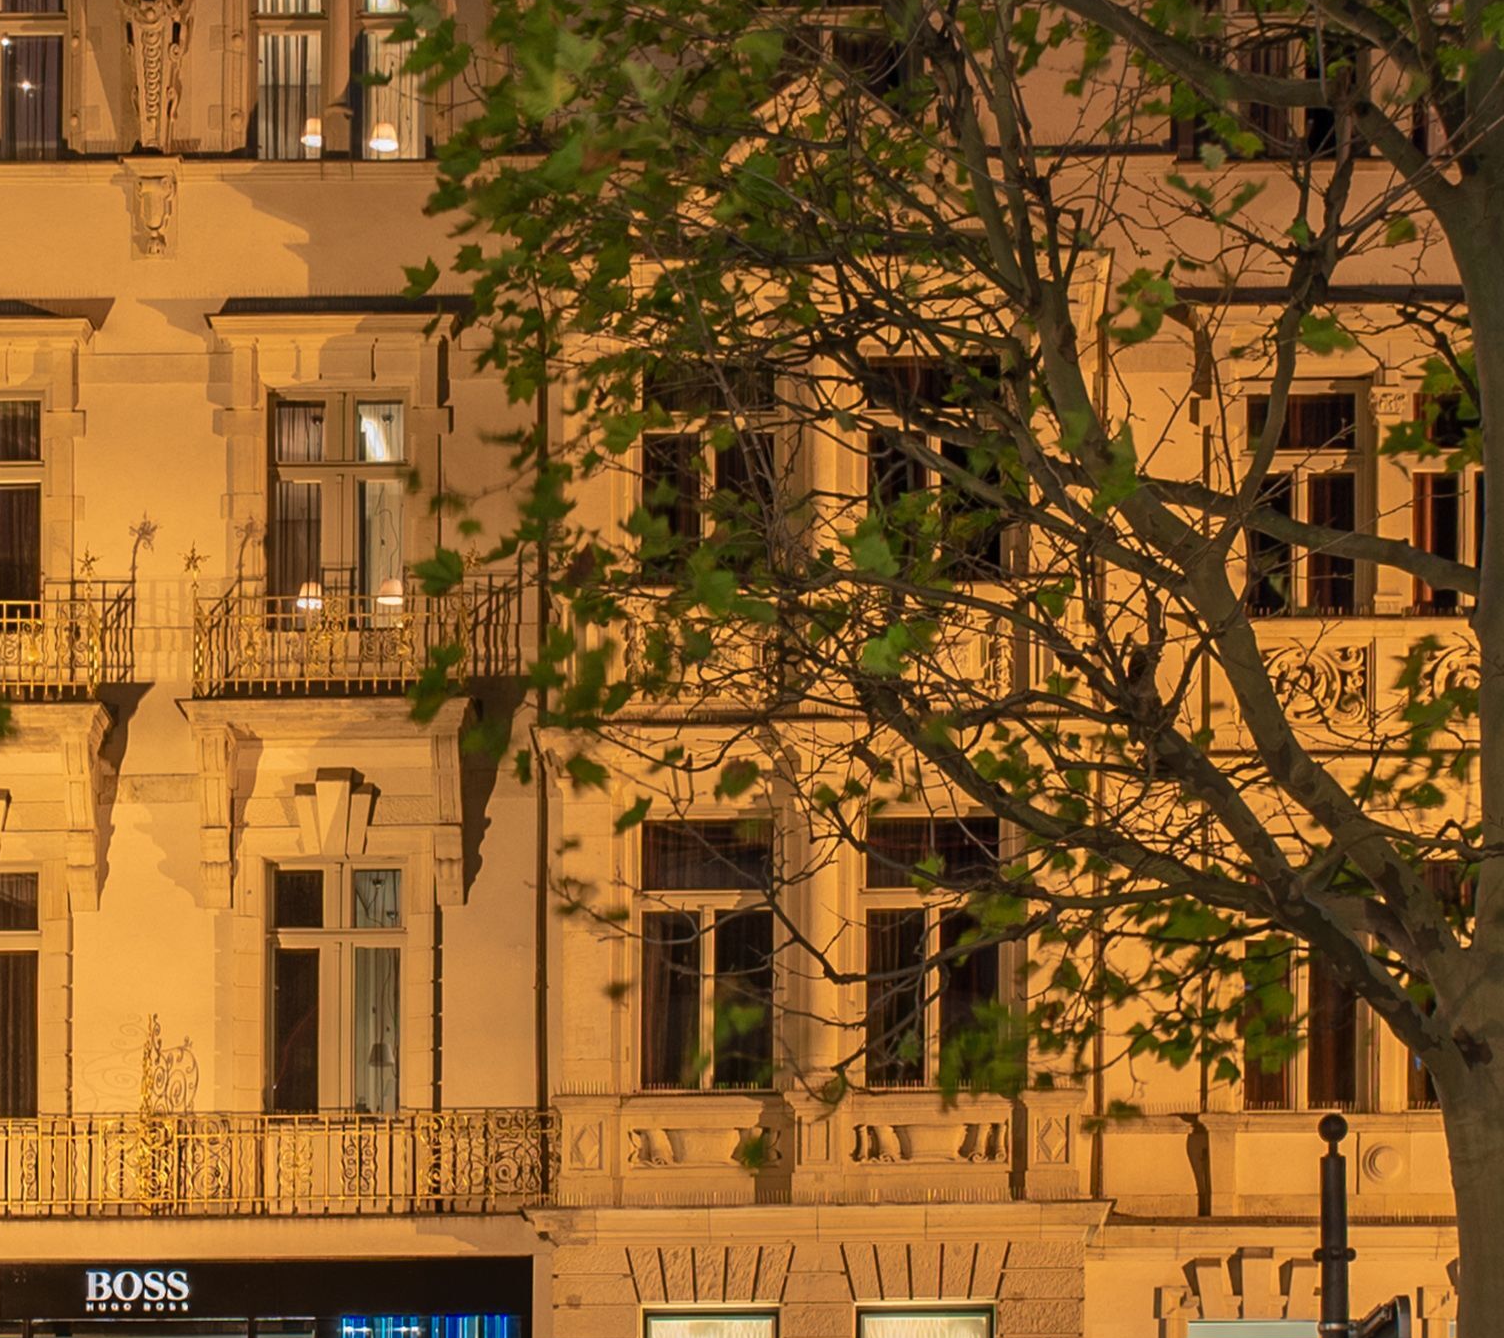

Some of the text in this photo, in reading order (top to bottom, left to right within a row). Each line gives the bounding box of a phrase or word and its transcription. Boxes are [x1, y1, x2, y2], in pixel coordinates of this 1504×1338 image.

[86, 1270, 190, 1302] BOSS
[85, 1302, 190, 1312] HUGO BOSS
